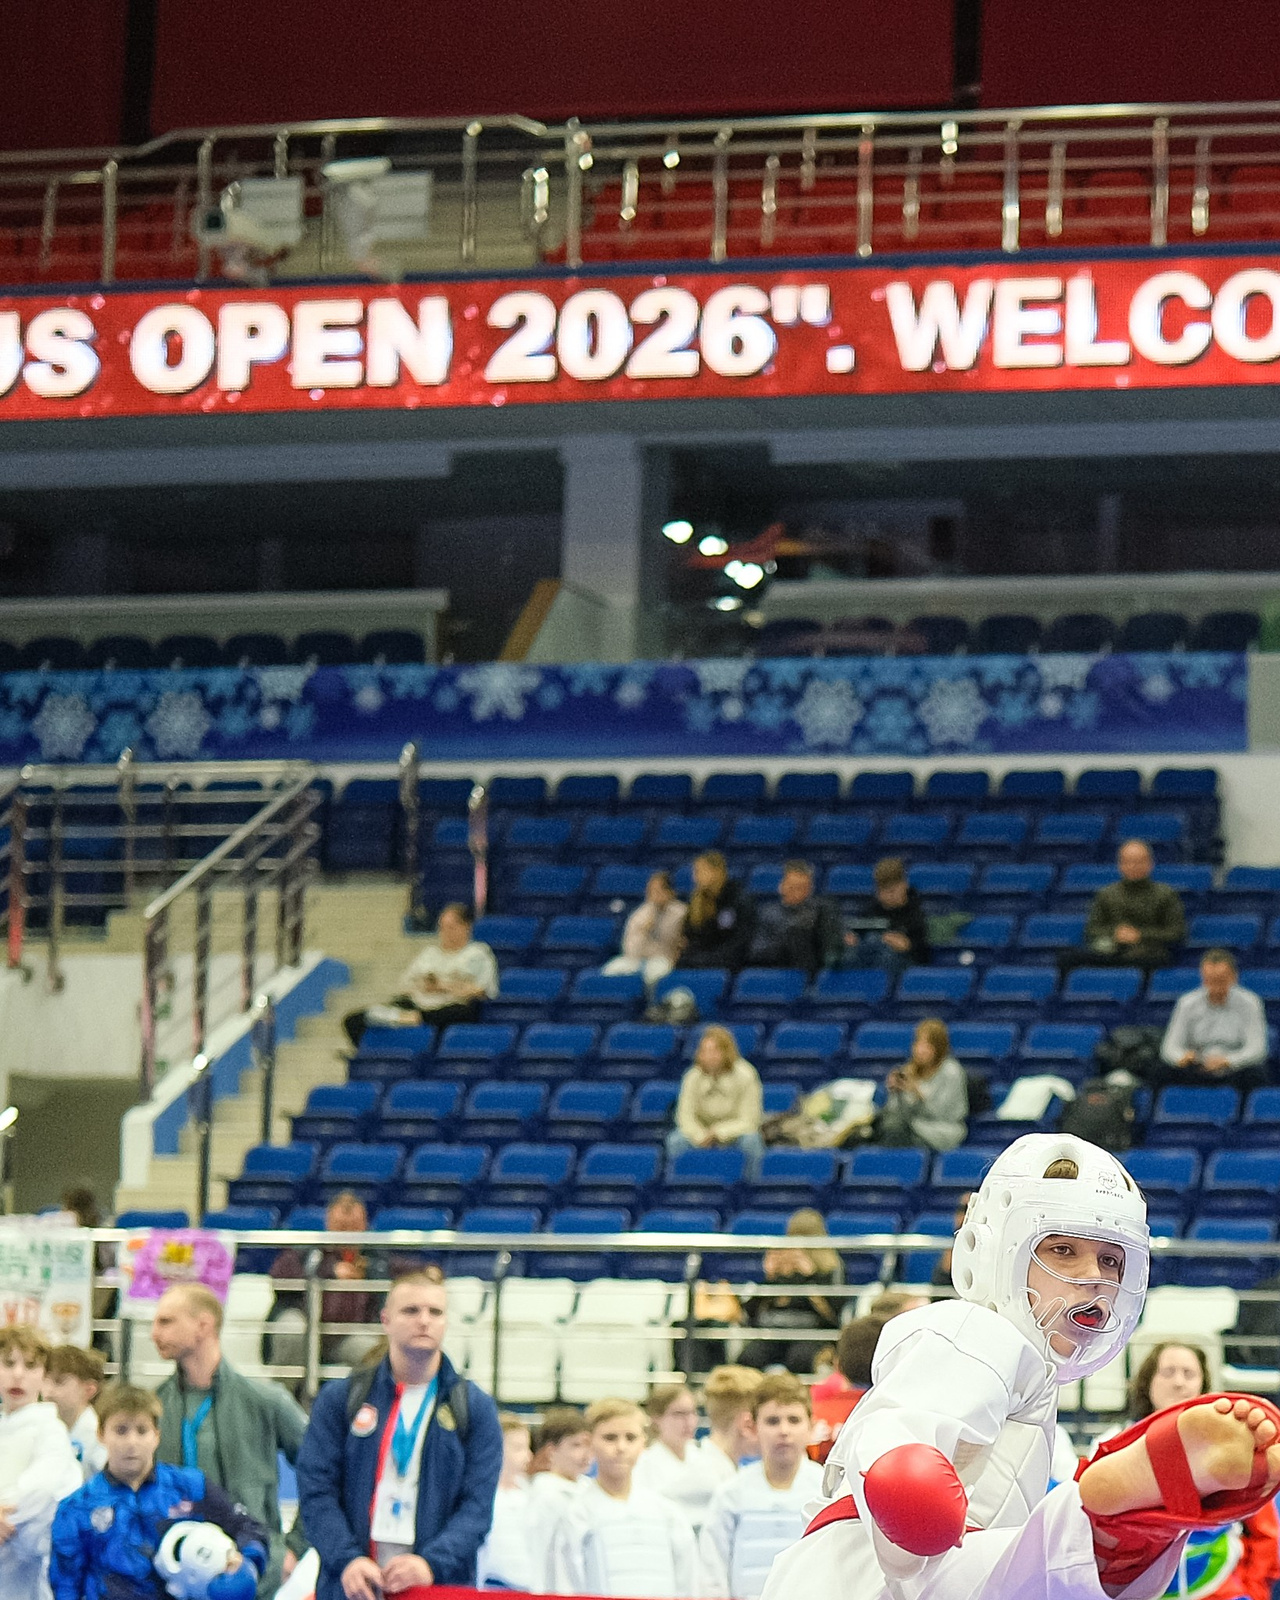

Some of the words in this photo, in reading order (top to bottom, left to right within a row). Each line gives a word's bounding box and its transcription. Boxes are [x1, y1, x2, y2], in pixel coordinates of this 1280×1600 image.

[0, 306, 101, 397] S
[130, 295, 454, 394] OPEN
[484, 284, 857, 385] 2026".
